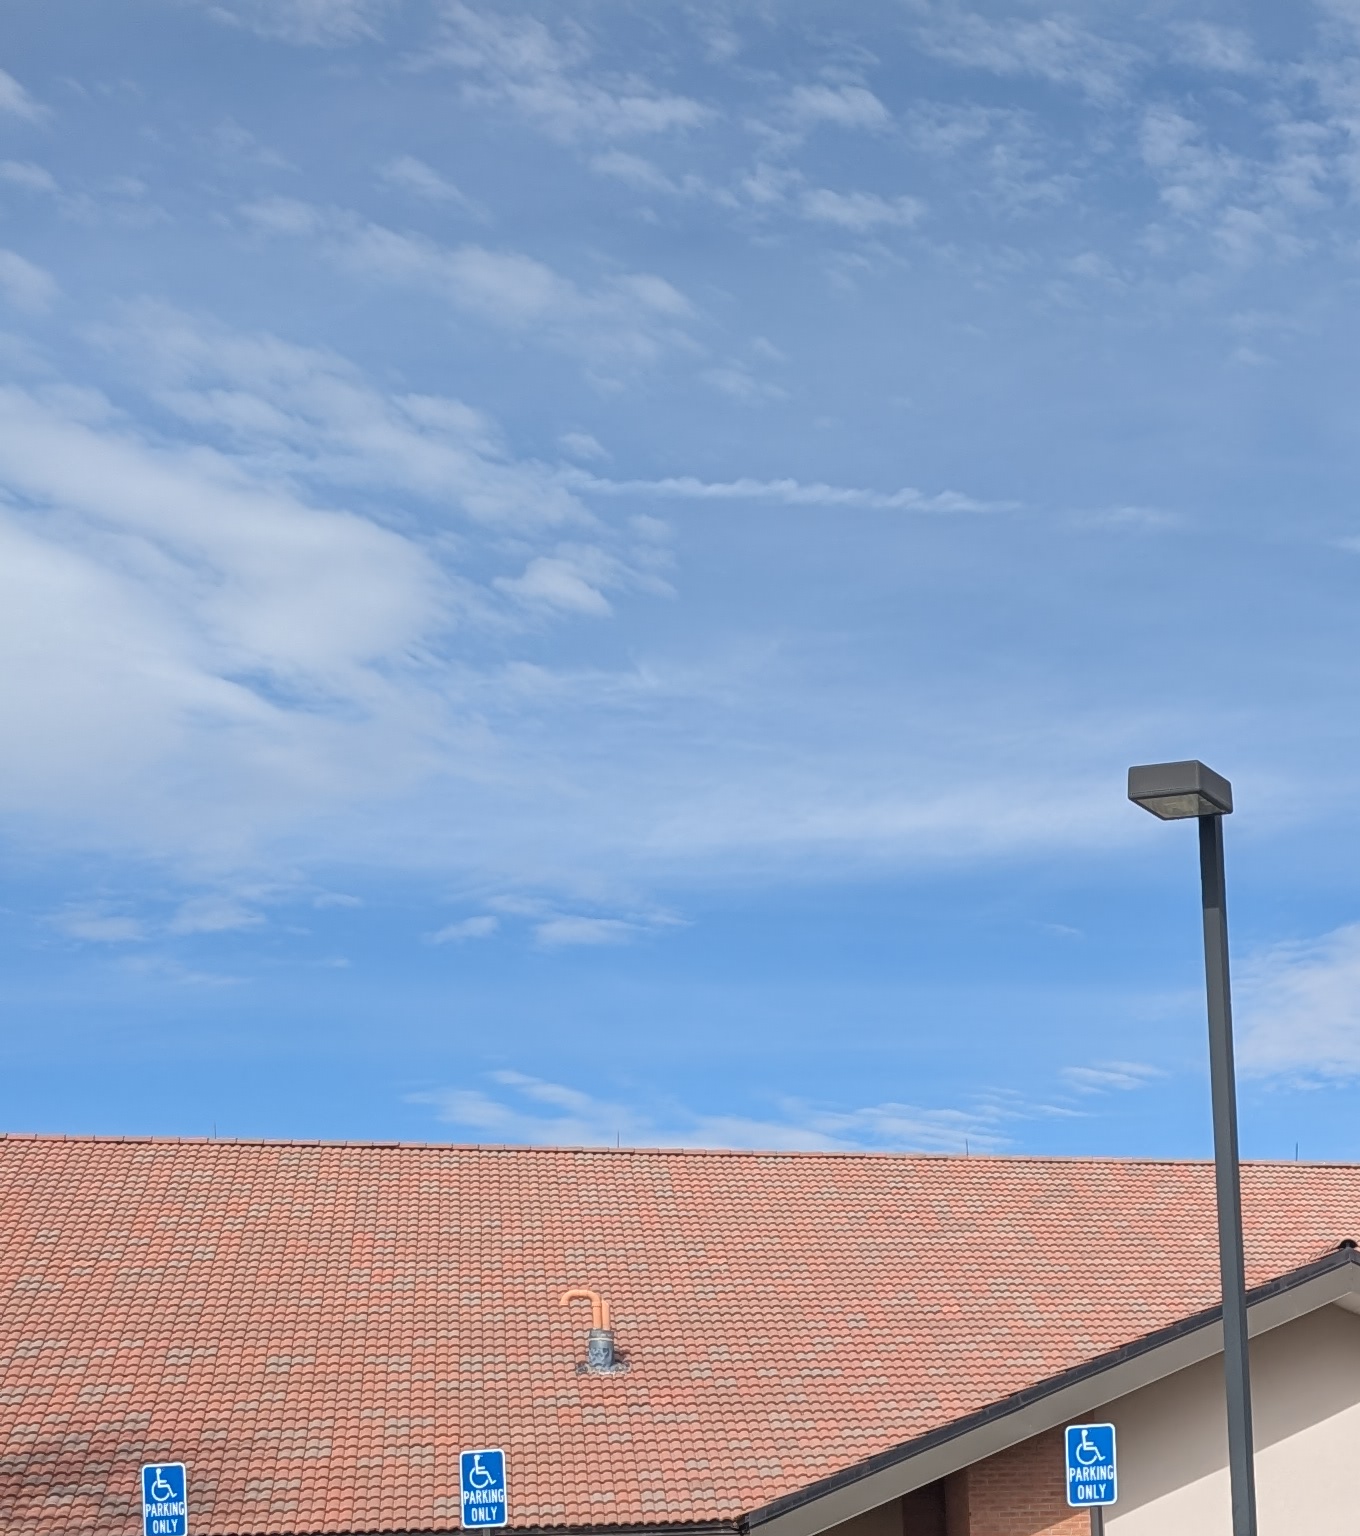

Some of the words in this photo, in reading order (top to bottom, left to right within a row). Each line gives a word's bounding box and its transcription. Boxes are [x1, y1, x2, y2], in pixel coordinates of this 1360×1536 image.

[1069, 1465, 1113, 1482] PARKING
[463, 1489, 504, 1505] PARKING
[1077, 1484, 1107, 1500] ONLY
[145, 1502, 185, 1518] PARKING
[471, 1507, 497, 1522] ONLY
[152, 1519, 178, 1534] ONLY
